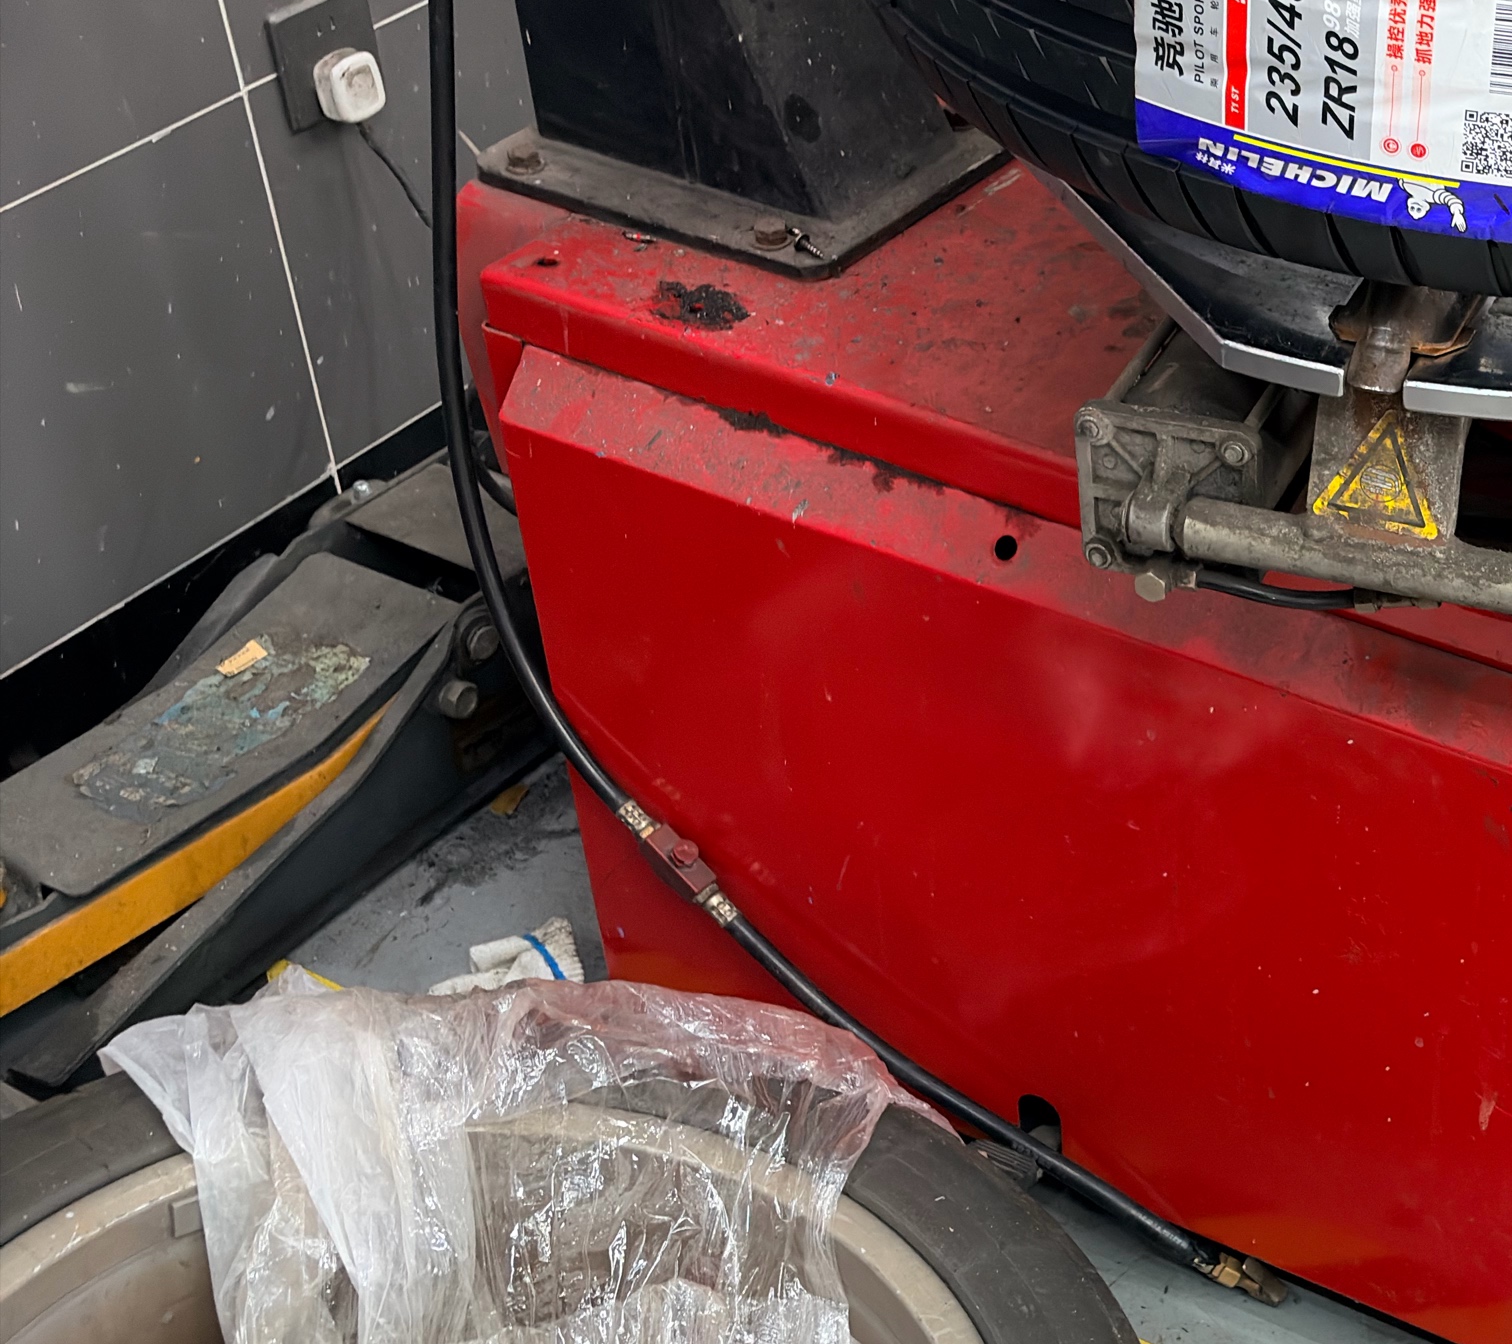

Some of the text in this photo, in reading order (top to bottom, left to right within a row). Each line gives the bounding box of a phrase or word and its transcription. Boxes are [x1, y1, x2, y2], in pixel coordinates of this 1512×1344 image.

[1194, 39, 1205, 84] PILOT
[1321, 30, 1359, 141] ZR18
[1198, 137, 1394, 203] MICHELIN
